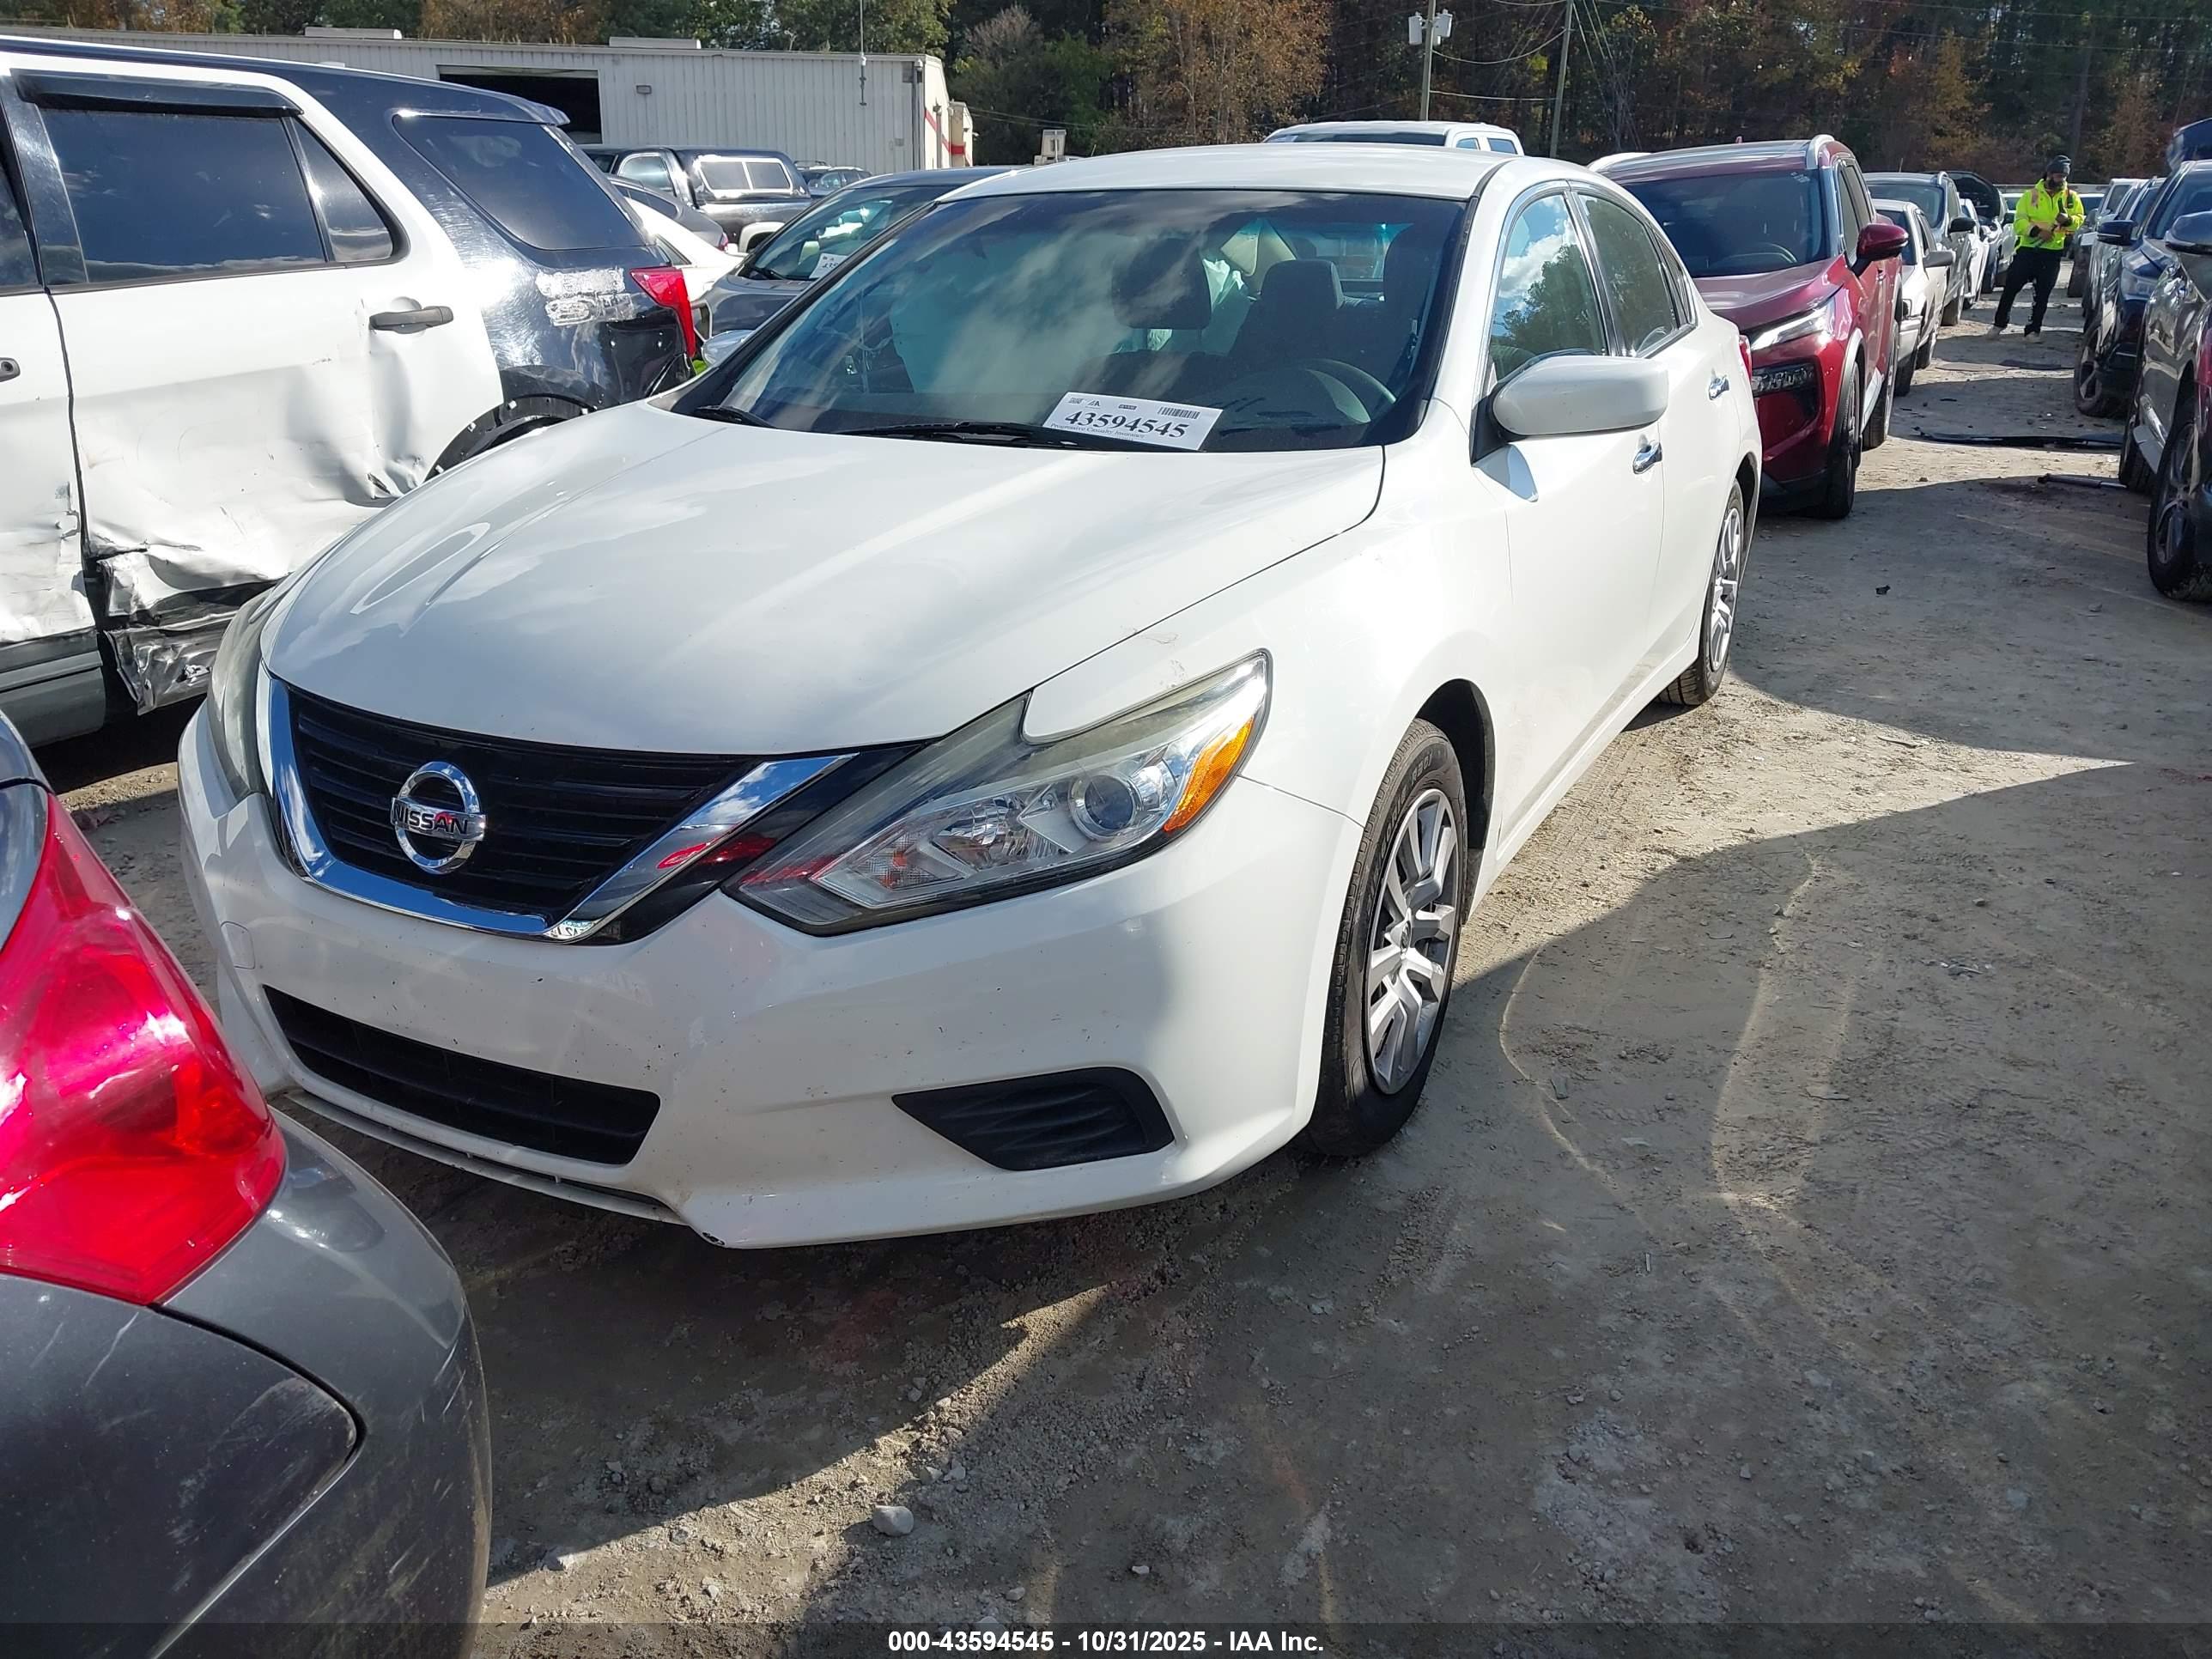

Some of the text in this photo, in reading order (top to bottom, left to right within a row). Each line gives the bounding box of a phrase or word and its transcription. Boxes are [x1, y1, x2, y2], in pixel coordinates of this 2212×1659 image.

[1050, 422, 1085, 431] Progressive
[1114, 430, 1146, 439] Insurance
[1065, 410, 1189, 438] 43594545
[393, 802, 469, 835] NISSAN
